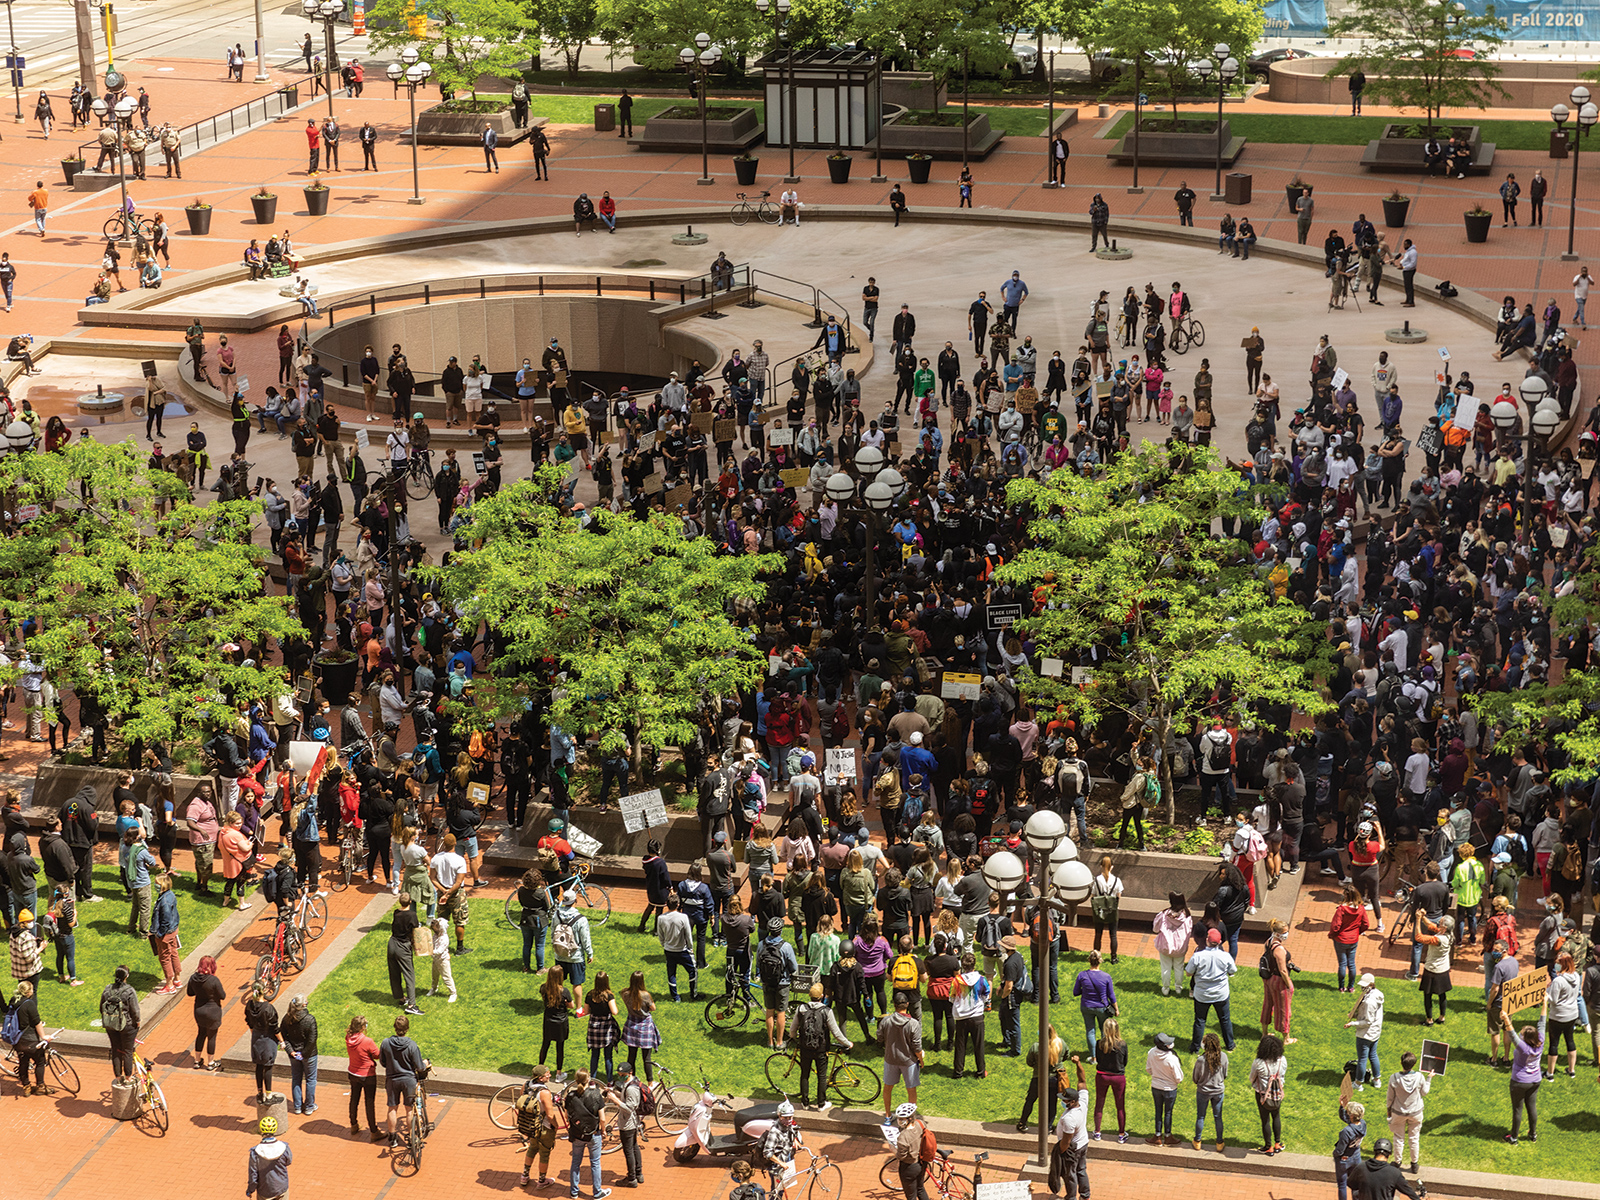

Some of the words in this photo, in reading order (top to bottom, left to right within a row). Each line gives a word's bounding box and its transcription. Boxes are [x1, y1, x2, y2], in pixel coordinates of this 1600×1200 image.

[1512, 12, 1541, 27] Fall
[1545, 12, 1584, 27] 2020
[1421, 432, 1435, 444] MEN
[1422, 424, 1437, 437] BLACK
[1417, 440, 1439, 455] MATTER
[832, 751, 840, 759] NO
[830, 763, 841, 773] NO
[623, 795, 640, 806] BLACK
[640, 791, 656, 801] LIVES
[1503, 977, 1525, 997] Black
[1528, 974, 1547, 987] Lives
[1507, 987, 1546, 1014] MATTER
